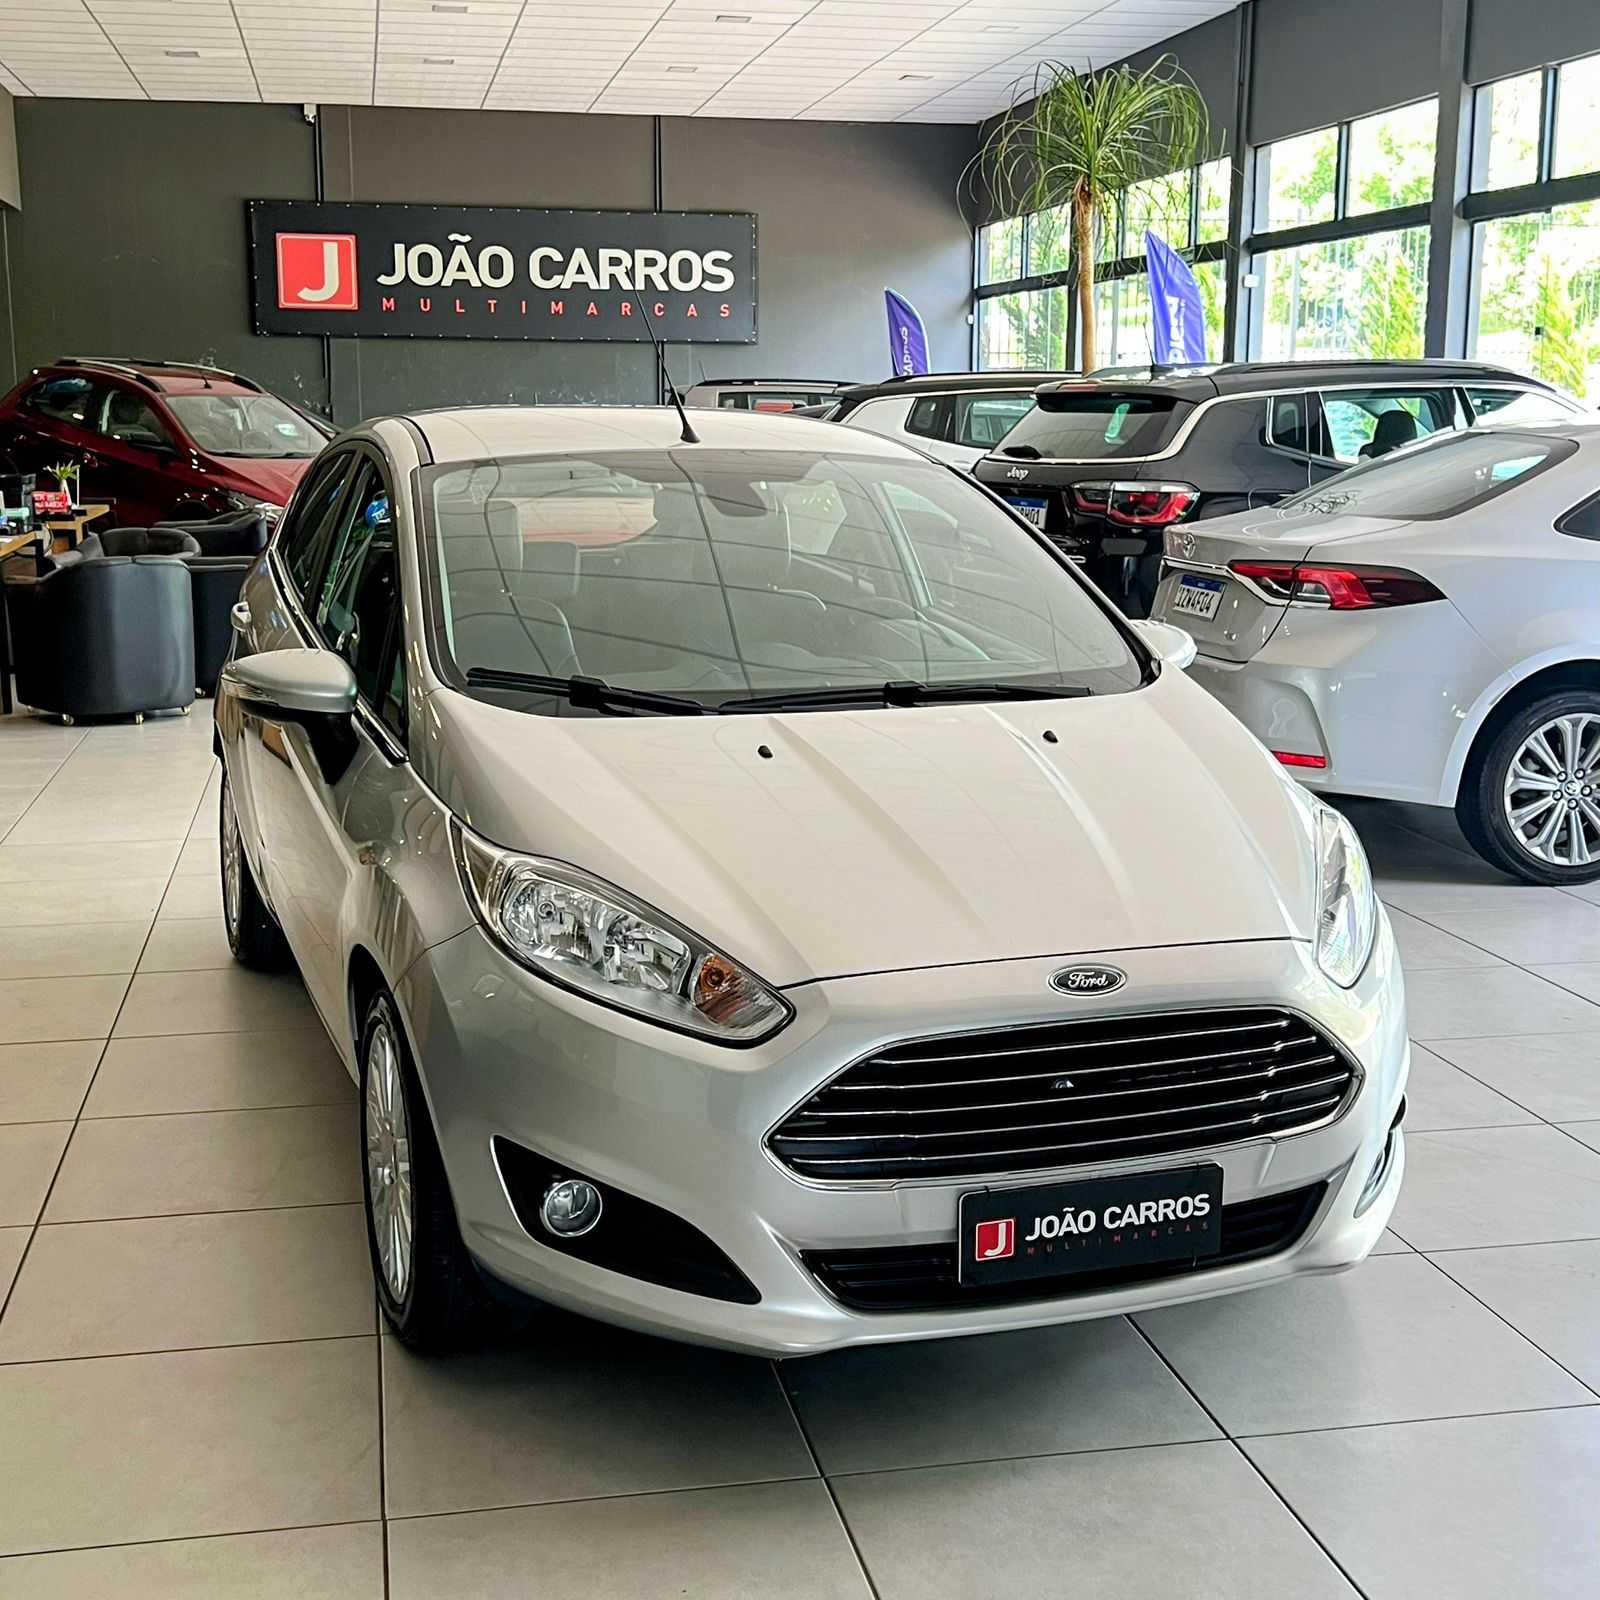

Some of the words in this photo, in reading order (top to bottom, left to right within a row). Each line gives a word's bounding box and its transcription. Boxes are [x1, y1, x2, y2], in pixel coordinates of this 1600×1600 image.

[297, 241, 340, 302] J
[376, 233, 515, 288] JOÃO
[528, 246, 735, 292] CARROS
[383, 296, 731, 318] MULTIMARCAS
[1067, 971, 1108, 988] Ford
[1025, 1206, 1096, 1241] JOÃO
[1103, 1193, 1211, 1229] CARROS
[984, 1222, 1006, 1256] J
[1026, 1222, 1209, 1255] MULTIMARCAS
